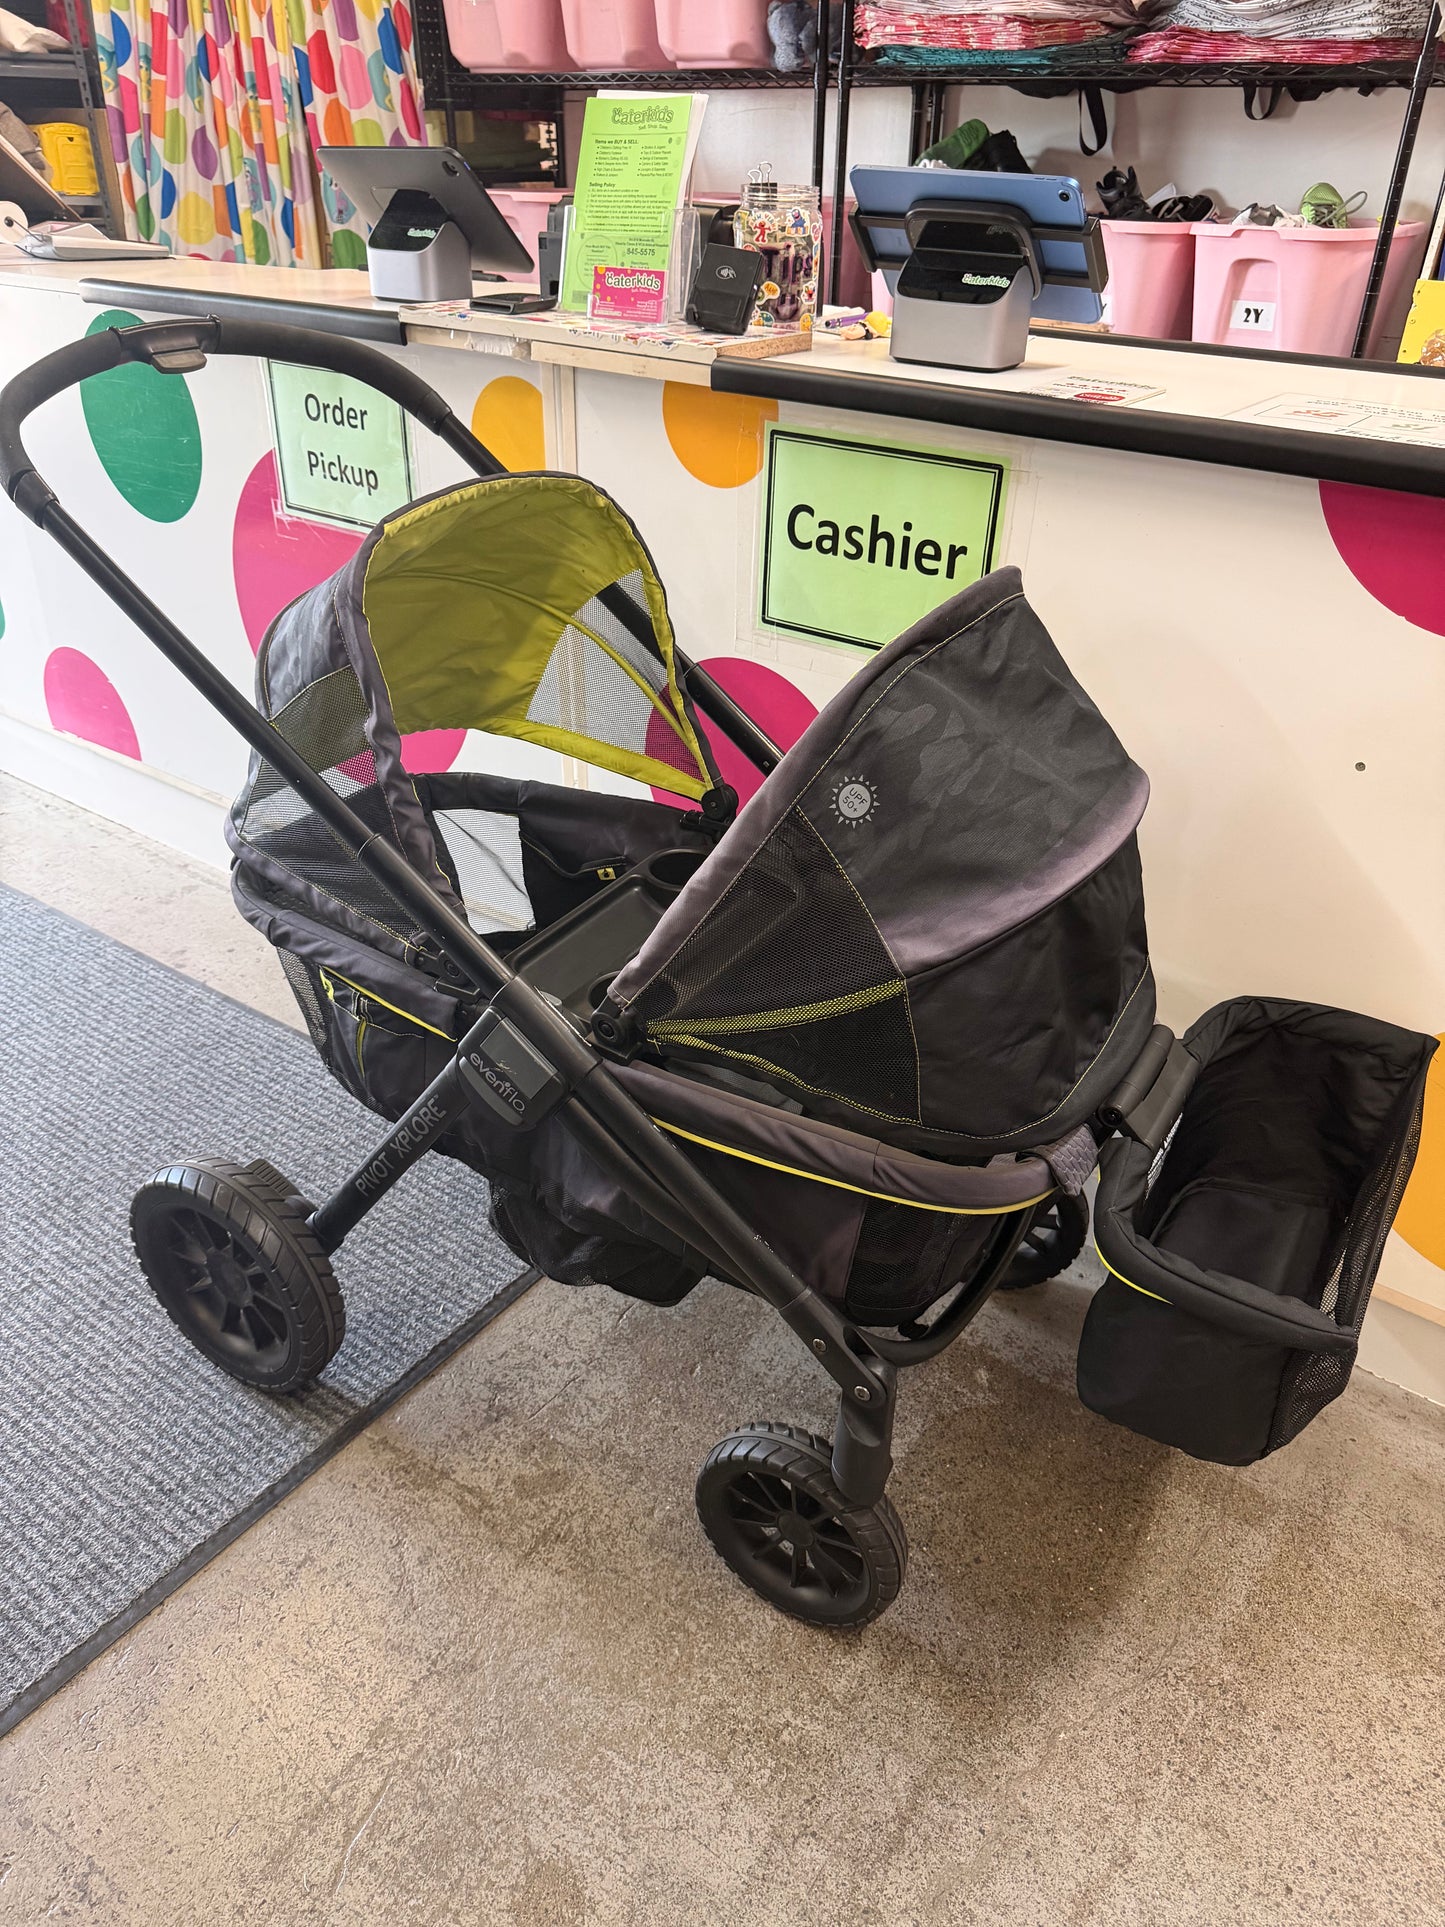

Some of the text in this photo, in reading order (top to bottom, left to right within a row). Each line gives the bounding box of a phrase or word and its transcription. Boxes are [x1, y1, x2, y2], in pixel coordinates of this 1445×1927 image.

[1243, 308, 1264, 323] 2Y
[304, 393, 368, 430] Order
[307, 450, 379, 496] Pickup
[787, 503, 968, 580] Cashier
[842, 796, 858, 813] 50+
[849, 787, 868, 805] UPF
[470, 1052, 526, 1114] evenflo
[355, 1099, 447, 1197] PIVOT XPLORE
